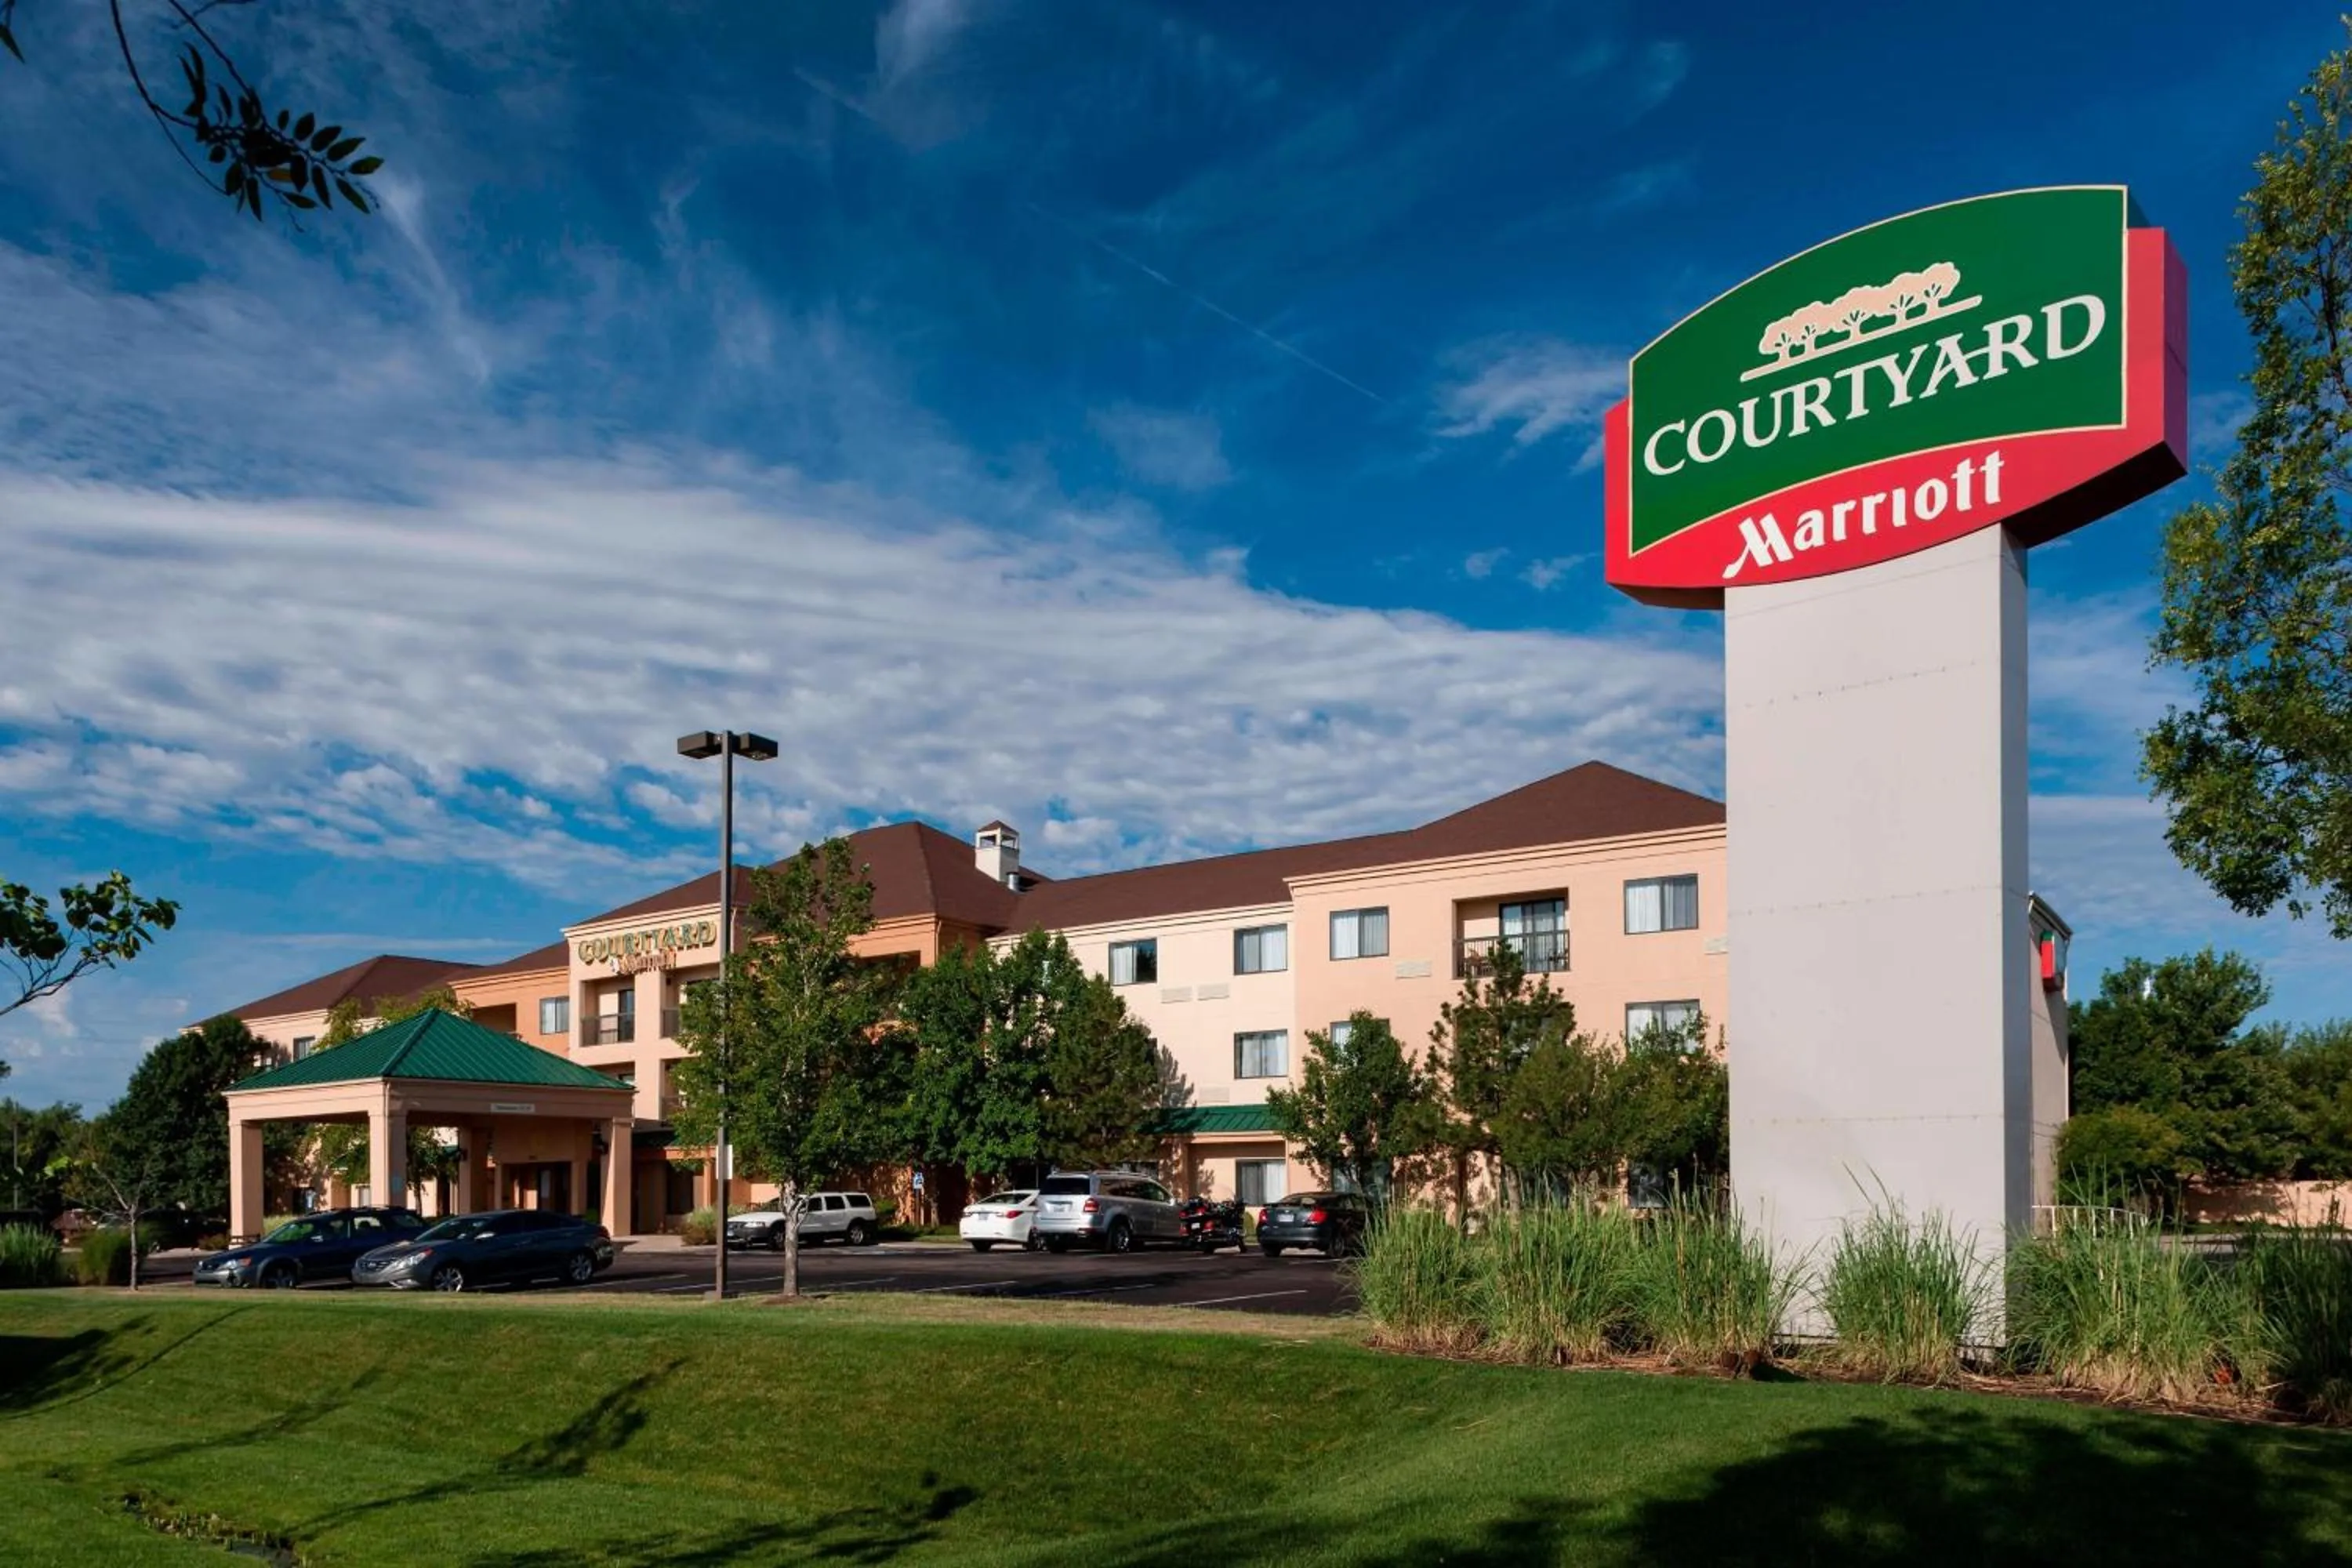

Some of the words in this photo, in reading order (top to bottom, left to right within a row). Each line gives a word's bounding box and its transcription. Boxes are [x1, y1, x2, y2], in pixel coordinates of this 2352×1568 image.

[1643, 295, 2106, 475] COURTYARD
[1723, 451, 2004, 579] Marriott
[579, 921, 717, 963] COURTYARD
